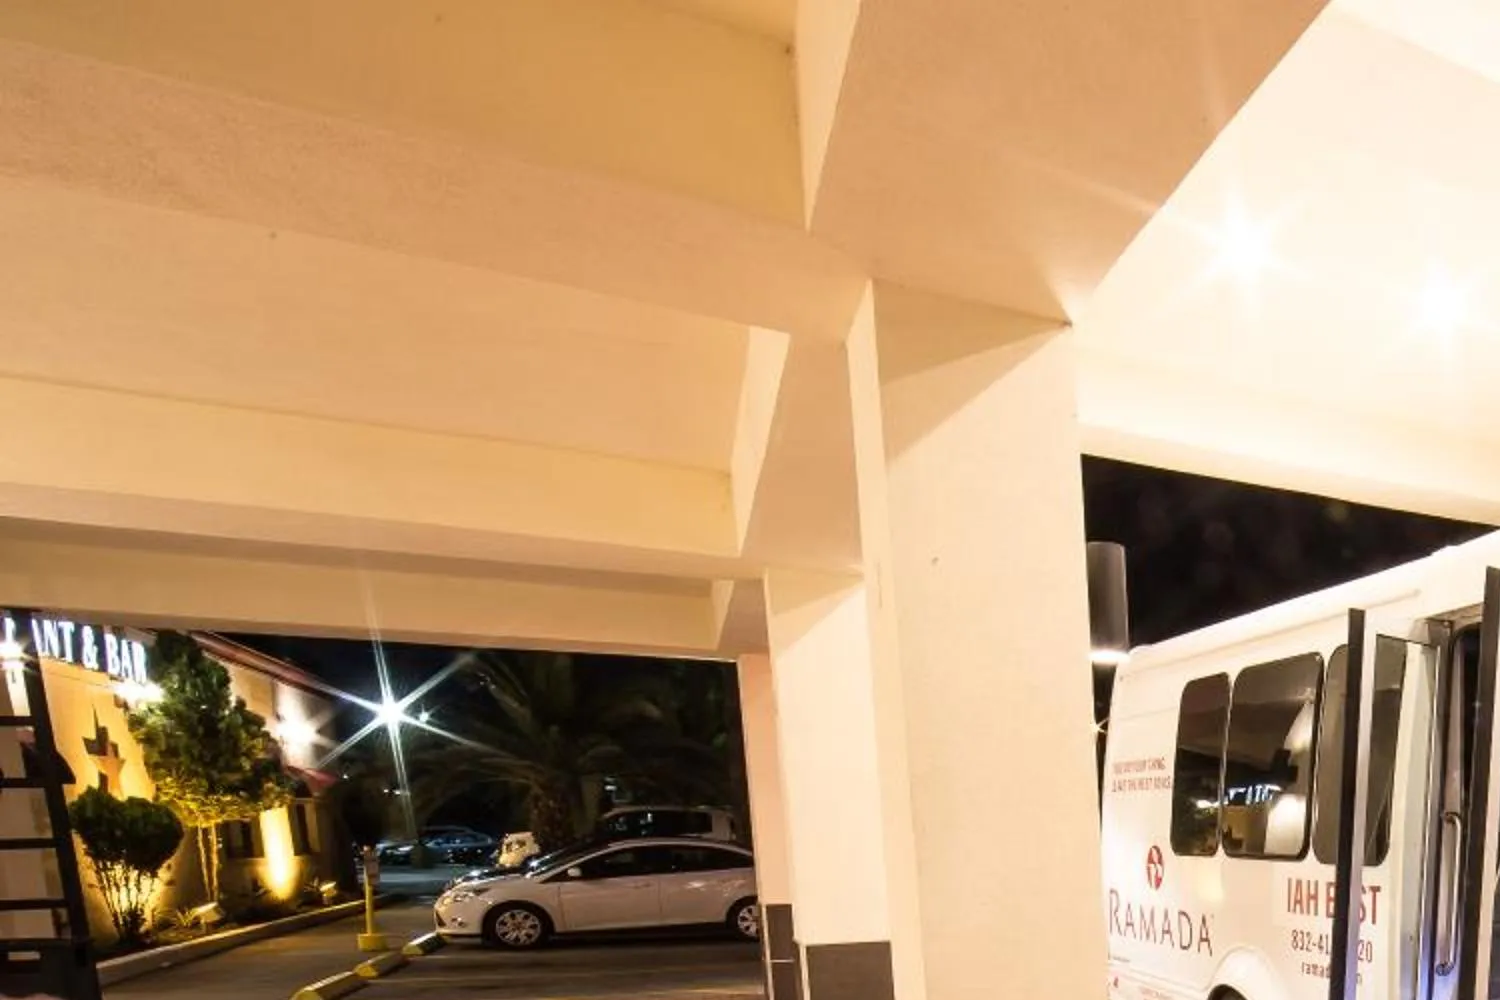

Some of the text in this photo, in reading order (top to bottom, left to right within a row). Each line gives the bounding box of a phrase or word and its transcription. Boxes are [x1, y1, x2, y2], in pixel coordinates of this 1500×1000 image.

[81, 624, 99, 670] &
[1109, 888, 1213, 957] RAMADA
[1287, 878, 1382, 924] IAH EST
